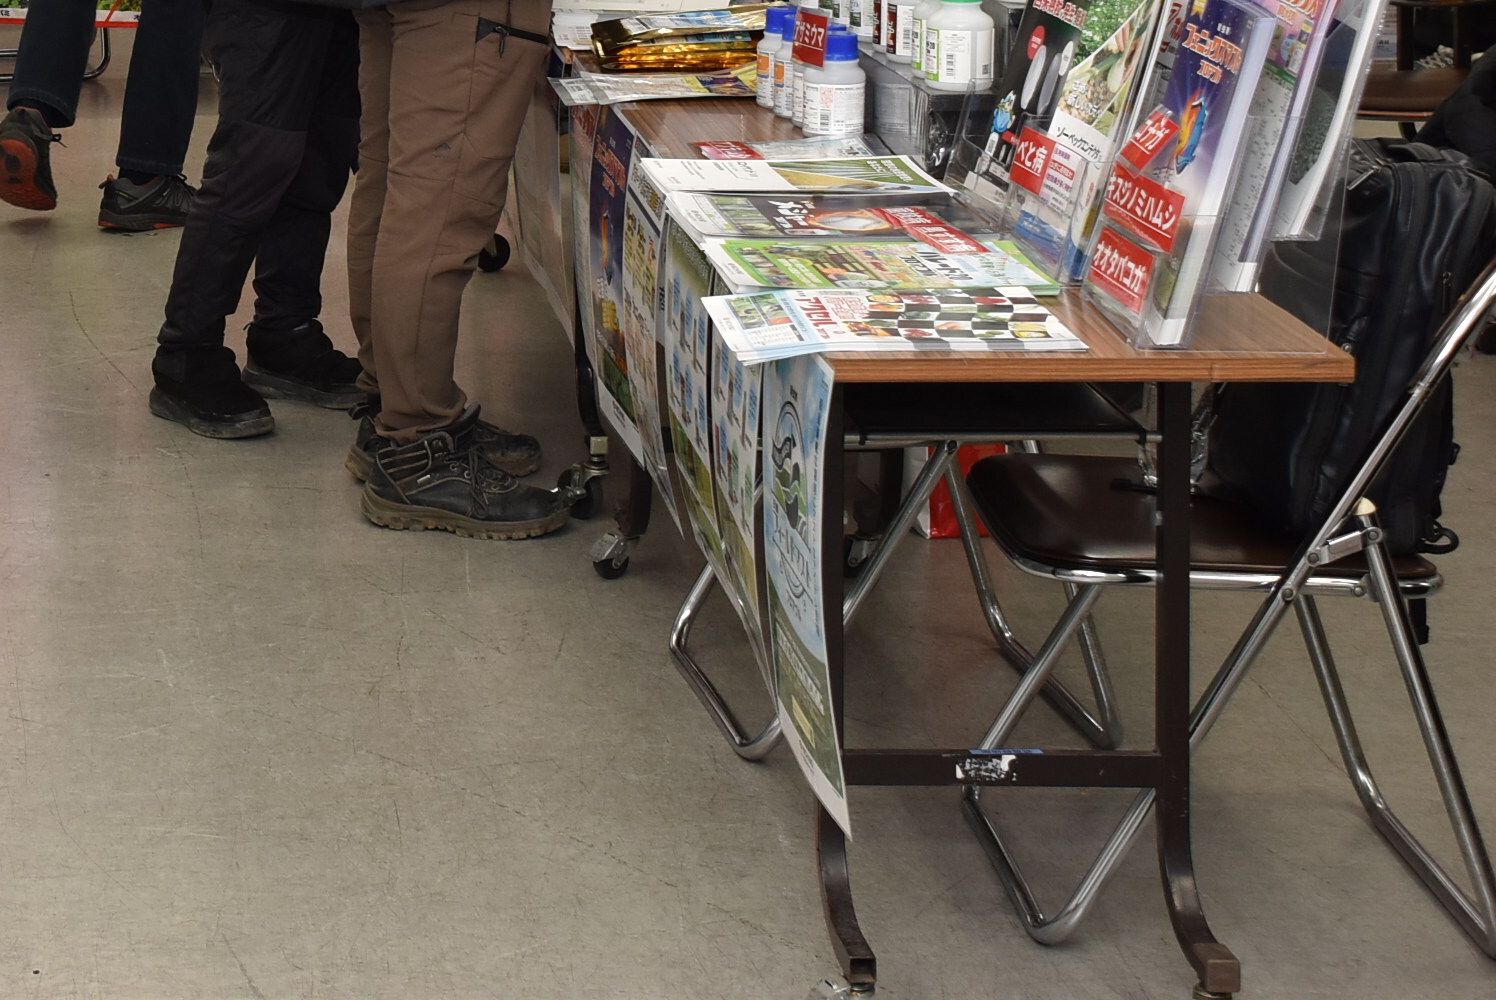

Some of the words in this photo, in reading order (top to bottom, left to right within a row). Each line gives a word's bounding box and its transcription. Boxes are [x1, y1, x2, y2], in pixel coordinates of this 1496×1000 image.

[1135, 116, 1172, 150] コナガ
[1017, 141, 1048, 174] べと病
[1106, 166, 1177, 231] キスジノミハムシ
[1092, 240, 1148, 294] オオタバコガ
